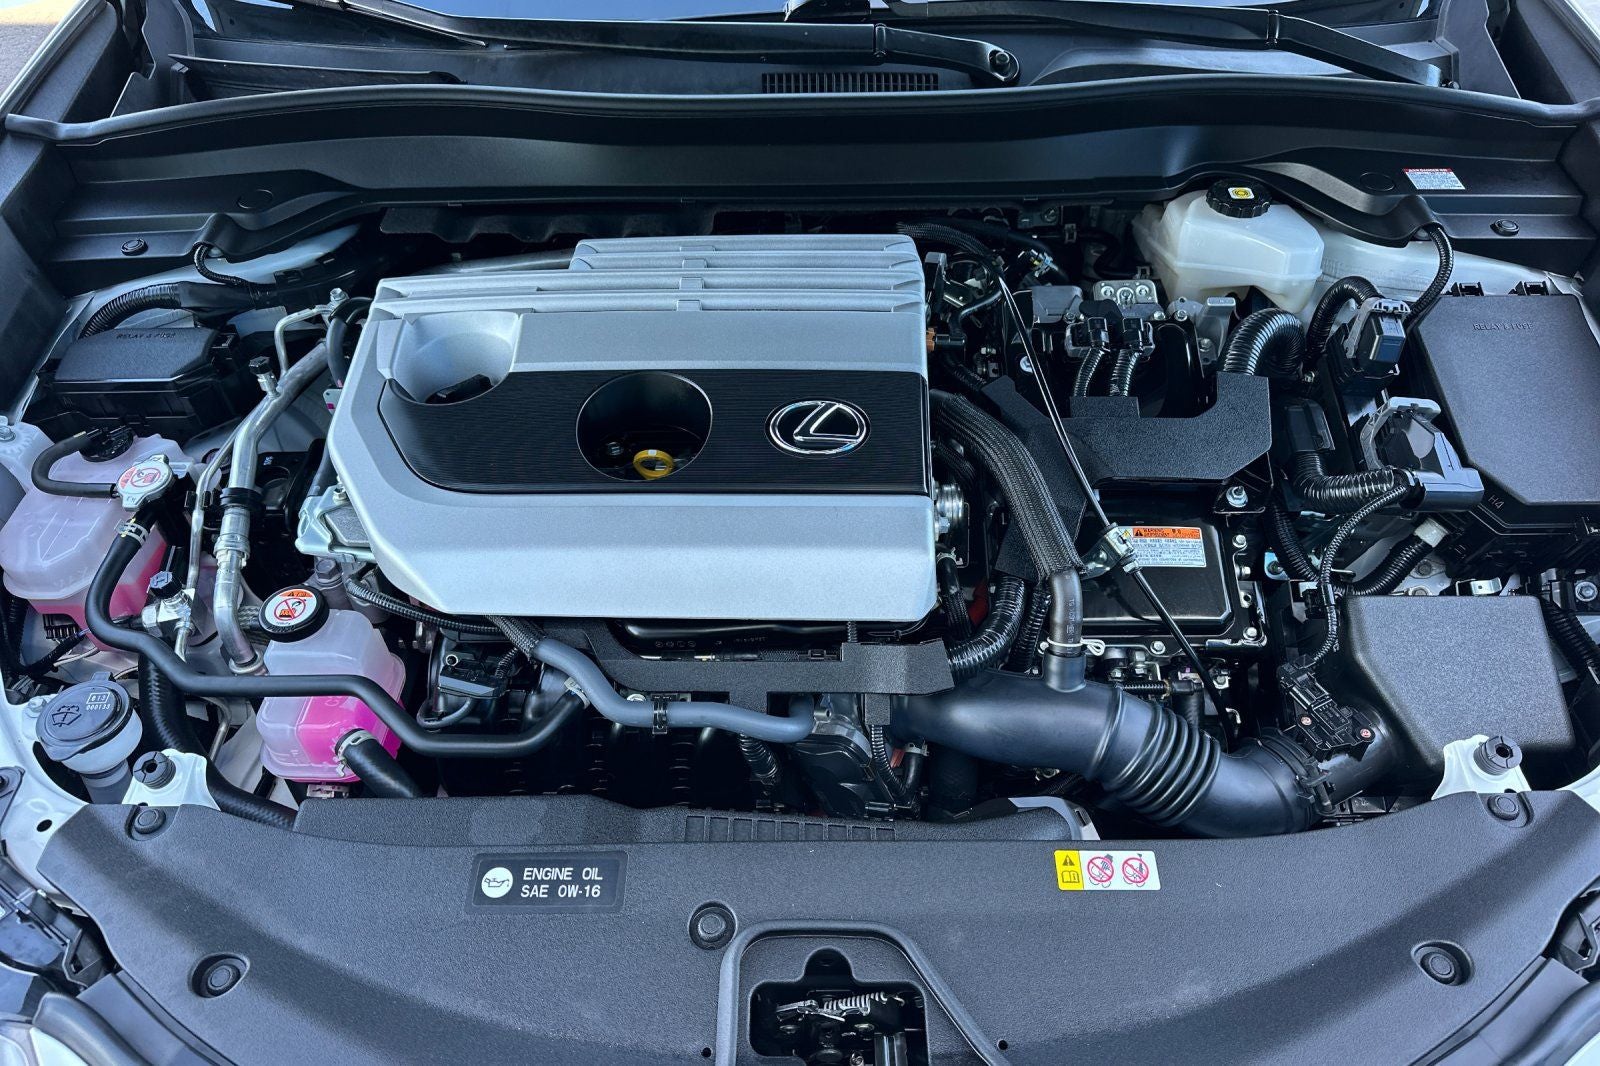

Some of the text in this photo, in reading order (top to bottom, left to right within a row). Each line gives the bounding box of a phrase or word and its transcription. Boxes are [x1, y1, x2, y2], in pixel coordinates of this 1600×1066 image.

[1473, 323, 1501, 331] RELAY
[1488, 494, 1505, 509] H4
[523, 867, 603, 880] ENGINE OIL
[520, 884, 601, 898] SAE 0W-16
